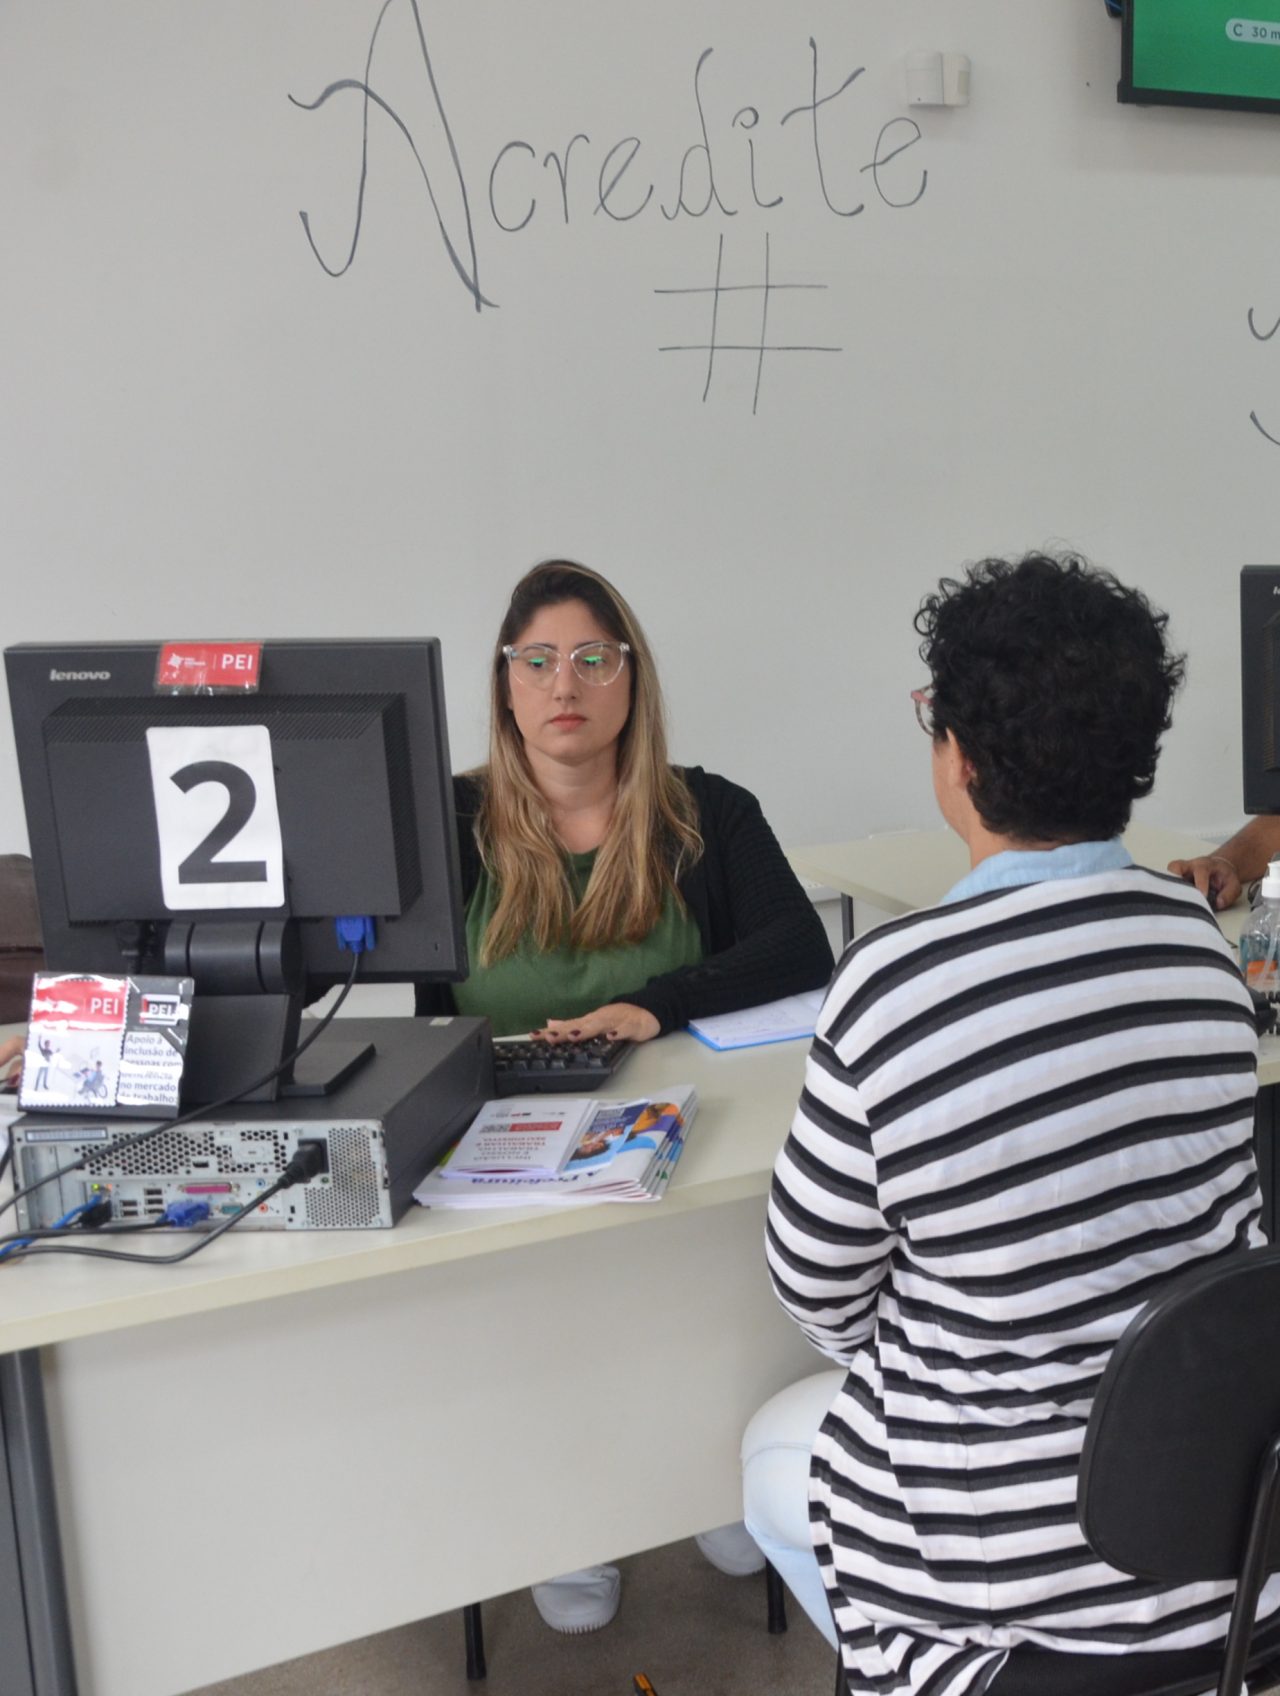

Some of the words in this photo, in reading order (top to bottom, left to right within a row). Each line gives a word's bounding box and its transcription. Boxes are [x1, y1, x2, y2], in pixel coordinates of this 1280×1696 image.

[1233, 23, 1244, 37] C
[1252, 26, 1268, 39] 30
[288, 0, 928, 313] Acredite
[222, 653, 253, 670] PEI
[49, 668, 111, 681] lenovo
[169, 760, 268, 885] 2
[91, 997, 119, 1015] PEI
[125, 1046, 164, 1057] inclusão
[134, 1082, 177, 1093] mercado
